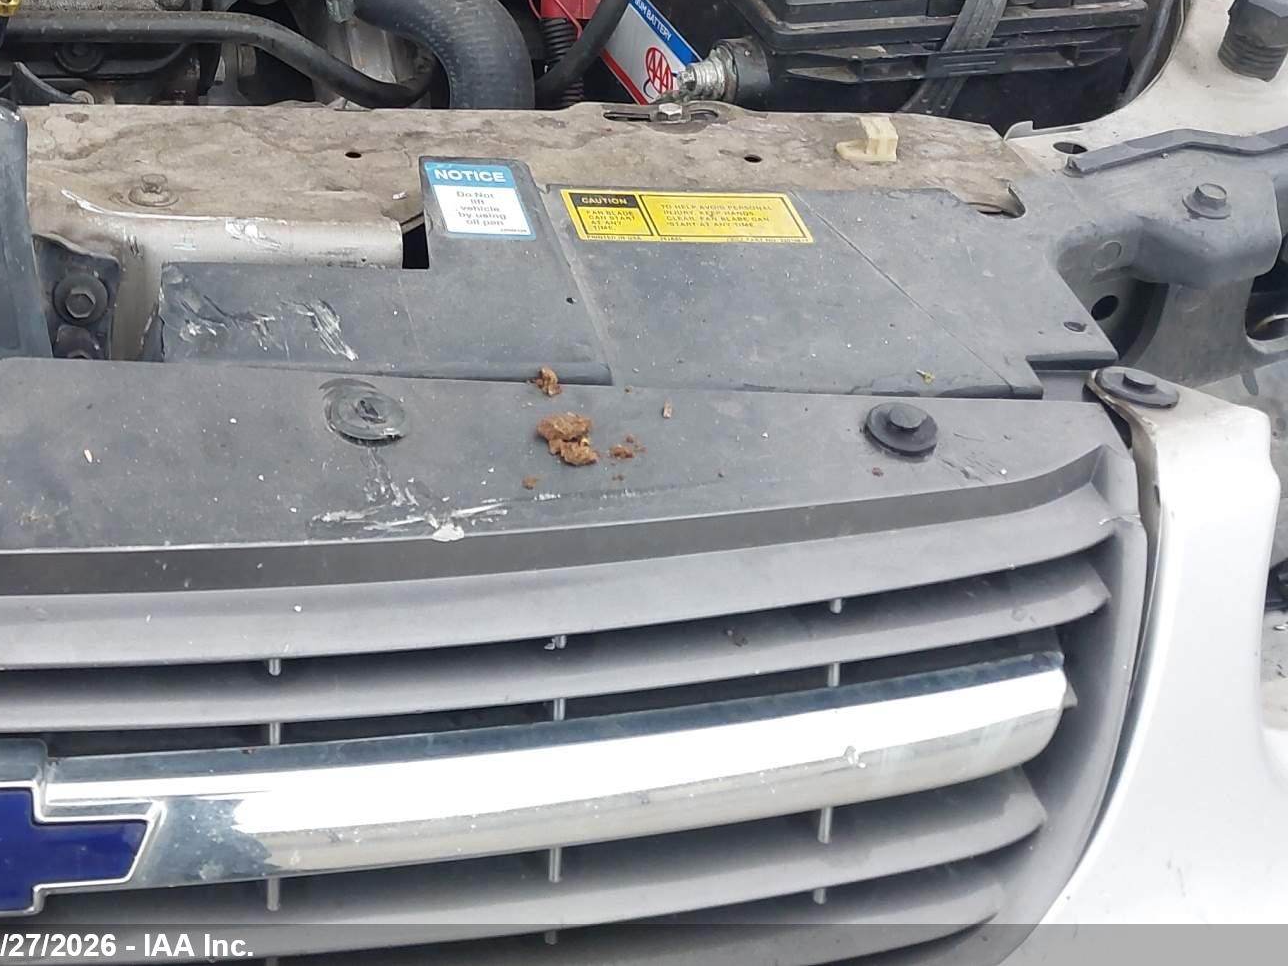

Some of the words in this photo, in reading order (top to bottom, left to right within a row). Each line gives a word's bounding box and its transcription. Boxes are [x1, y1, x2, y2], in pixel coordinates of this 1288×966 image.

[646, 8, 672, 41] BATTERY
[433, 169, 507, 183] NOTICE
[475, 191, 495, 199] Not
[580, 197, 628, 206] CAUTION
[458, 212, 472, 220] by
[475, 213, 508, 221] using
